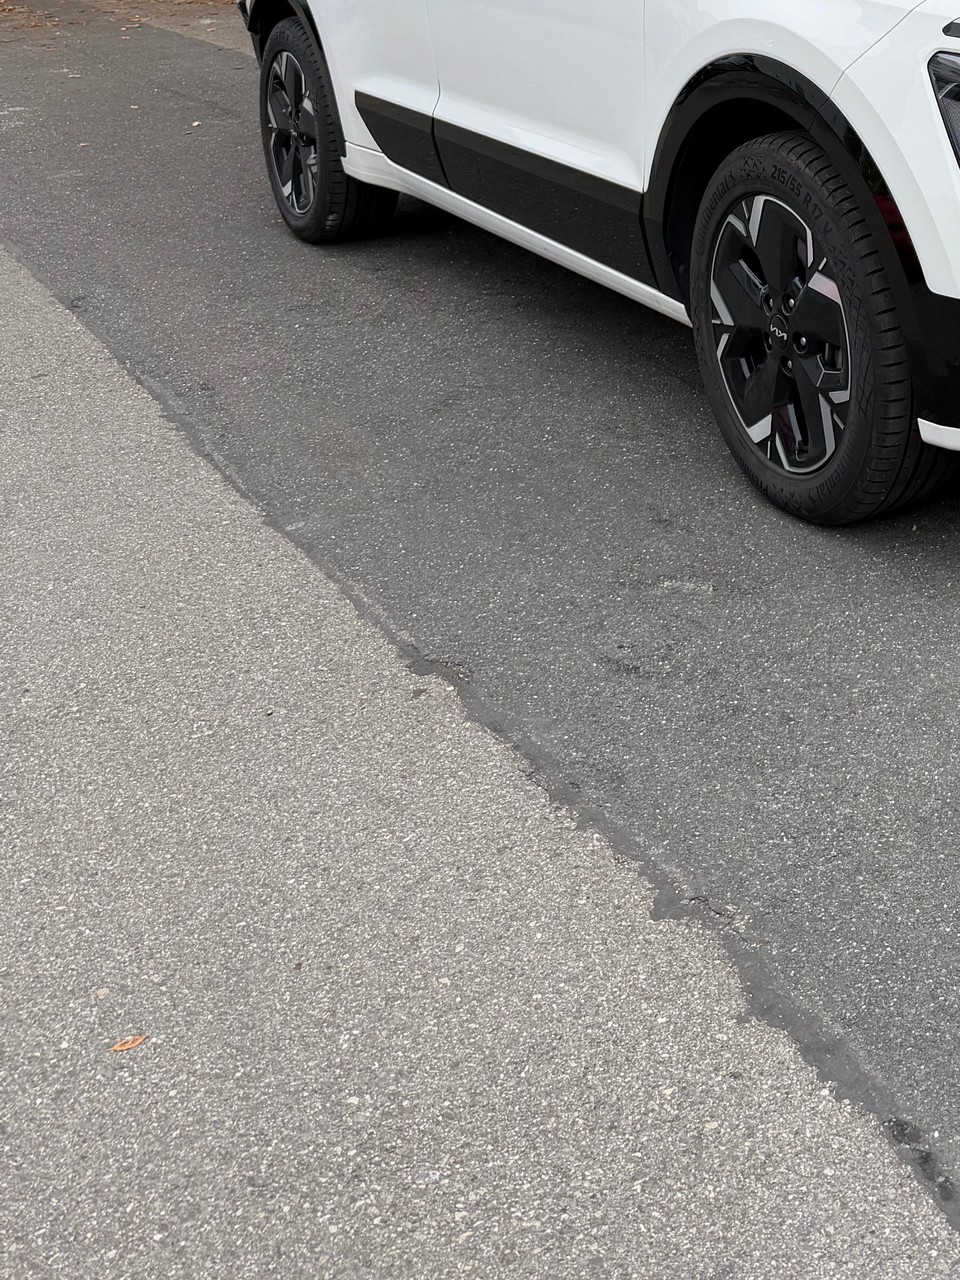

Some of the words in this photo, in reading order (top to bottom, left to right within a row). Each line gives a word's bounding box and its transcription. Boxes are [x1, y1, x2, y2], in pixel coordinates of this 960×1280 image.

[771, 164, 803, 198] 215/55
[803, 192, 813, 208] R
[812, 203, 824, 220] 17
